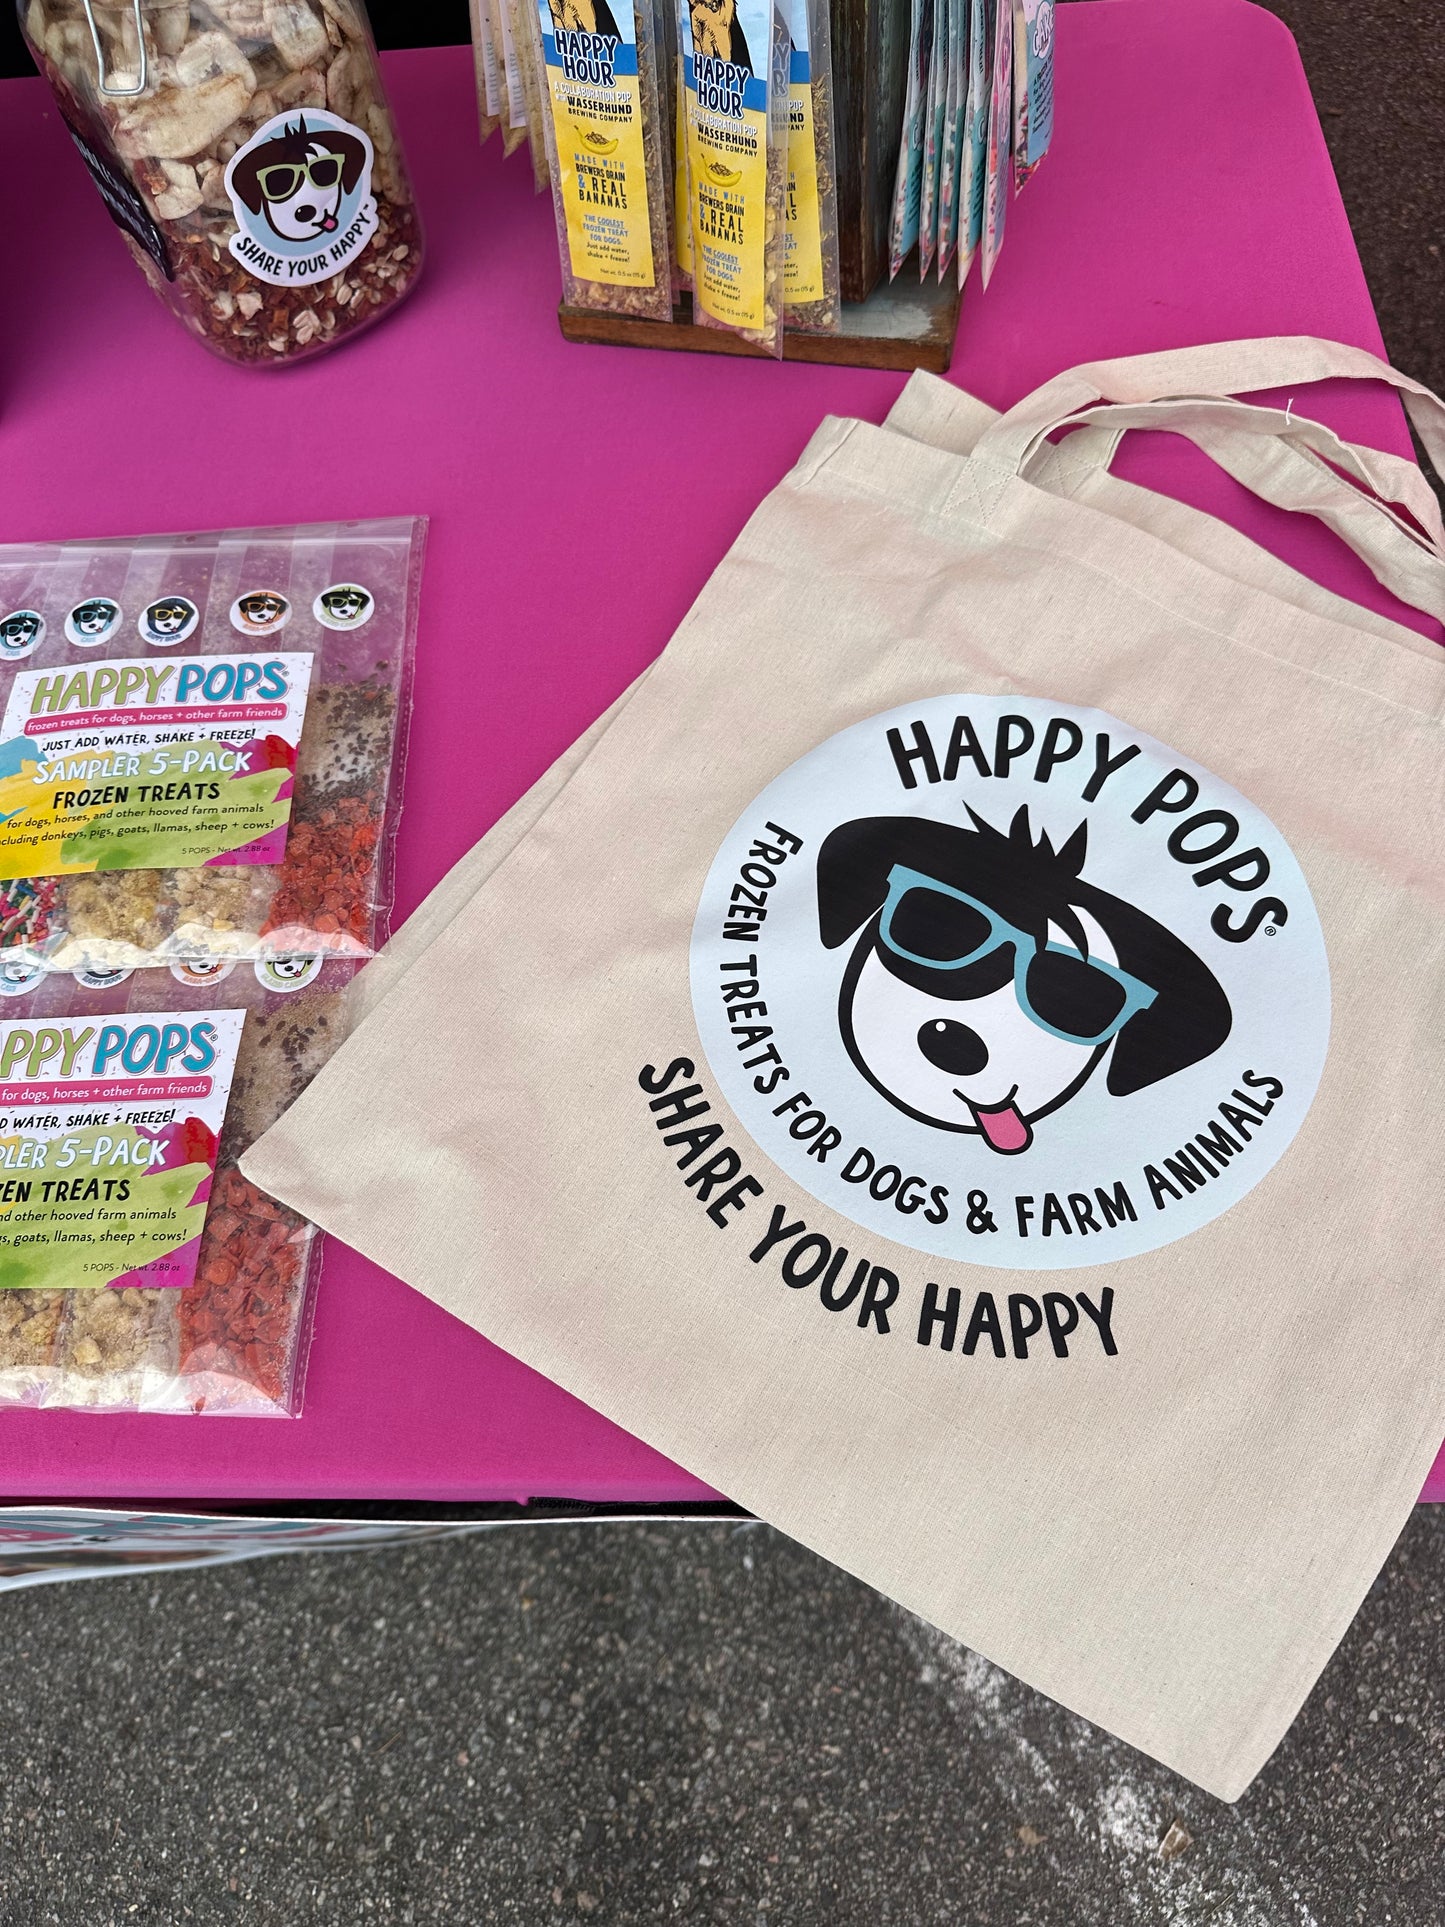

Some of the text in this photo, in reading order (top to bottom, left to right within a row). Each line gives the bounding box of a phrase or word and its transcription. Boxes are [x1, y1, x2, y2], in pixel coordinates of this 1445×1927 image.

[554, 28, 618, 62] HAPPY
[563, 54, 615, 88] HOUR
[693, 53, 749, 95] HAPPY
[560, 83, 614, 102] COLLABORATION
[616, 91, 632, 103] POP
[567, 96, 632, 114] WASSERHUND
[698, 80, 744, 119] HOUR
[568, 107, 633, 123] BREWING COMPANY
[789, 100, 804, 112] POP
[694, 108, 743, 135] COLLABORATION
[743, 124, 758, 137] POP
[697, 122, 758, 149] WASSERHUND
[697, 134, 758, 157] BREWING COMPANY
[574, 153, 625, 170] MADE WITH
[575, 163, 626, 182] BREWERS GRAIN
[578, 174, 627, 197] & REAL
[699, 181, 745, 205] MADE WITH
[579, 189, 628, 209] BANANAS
[699, 192, 745, 217] BREWERS GRAIN
[583, 223, 628, 238] FROZEN TREAT
[584, 214, 625, 230] THE COOLEST
[700, 204, 706, 219] &
[711, 209, 744, 233] REAL
[700, 219, 744, 245] BANANAS
[237, 237, 283, 276] SHARE
[288, 254, 329, 277] YOUR
[713, 249, 739, 265] COOLEST
[721, 262, 742, 275] TREAT
[30, 664, 175, 714] HAPPY
[27, 719, 58, 732] frozen
[60, 716, 89, 728] treats
[91, 714, 107, 725] for
[109, 712, 137, 726] dogs,
[139, 710, 173, 721] horses
[185, 709, 215, 720] other
[218, 707, 243, 719] farm
[246, 706, 283, 718] friends
[42, 739, 72, 752] JUST
[75, 736, 100, 749] ADD
[105, 733, 150, 747] WATER,
[155, 731, 194, 744] SHAKE
[210, 729, 256, 741] FREEZE!
[32, 750, 254, 784] SAMPLER 5-PACK
[887, 715, 1141, 802] HAPPY
[53, 782, 220, 809] FROZEN TREATS
[7, 803, 265, 829] for dogs, horses, and other hooved farm animals
[0, 834, 39, 846] cluding
[41, 829, 87, 842] donkeys,
[89, 827, 114, 840] pigs,
[117, 824, 150, 838] goats,
[153, 821, 192, 834] llamas,
[195, 820, 228, 834] sheep
[243, 819, 275, 830] cows!
[189, 846, 211, 855] POPS
[720, 822, 1284, 1238] FROZEN TREATS FOR DOGS & FARM ANIMALS
[0, 1027, 95, 1078] PPY
[1, 1082, 208, 1103] for dogs, horses + other farm friends
[13, 1115, 62, 1129] WATER,
[66, 1113, 110, 1127] SHAKE
[113, 1116, 121, 1124] +
[125, 1109, 177, 1125] FREEZE!
[56, 1136, 170, 1168] 5-PACK
[41, 1178, 131, 1203] TREATS
[15, 1209, 47, 1222] other
[50, 1208, 94, 1222] hooved
[97, 1207, 126, 1221] farm
[130, 1207, 177, 1220] animals
[639, 1057, 1119, 1359] SHARE YOUR HAPPY
[14, 1231, 50, 1247] goats,
[54, 1230, 96, 1244] llamas,
[100, 1230, 135, 1245] sheep
[140, 1232, 148, 1240] +
[152, 1229, 187, 1241] cows!
[83, 1263, 89, 1272] 5
[90, 1263, 114, 1272] POPS
[151, 1262, 170, 1271] 2.88
